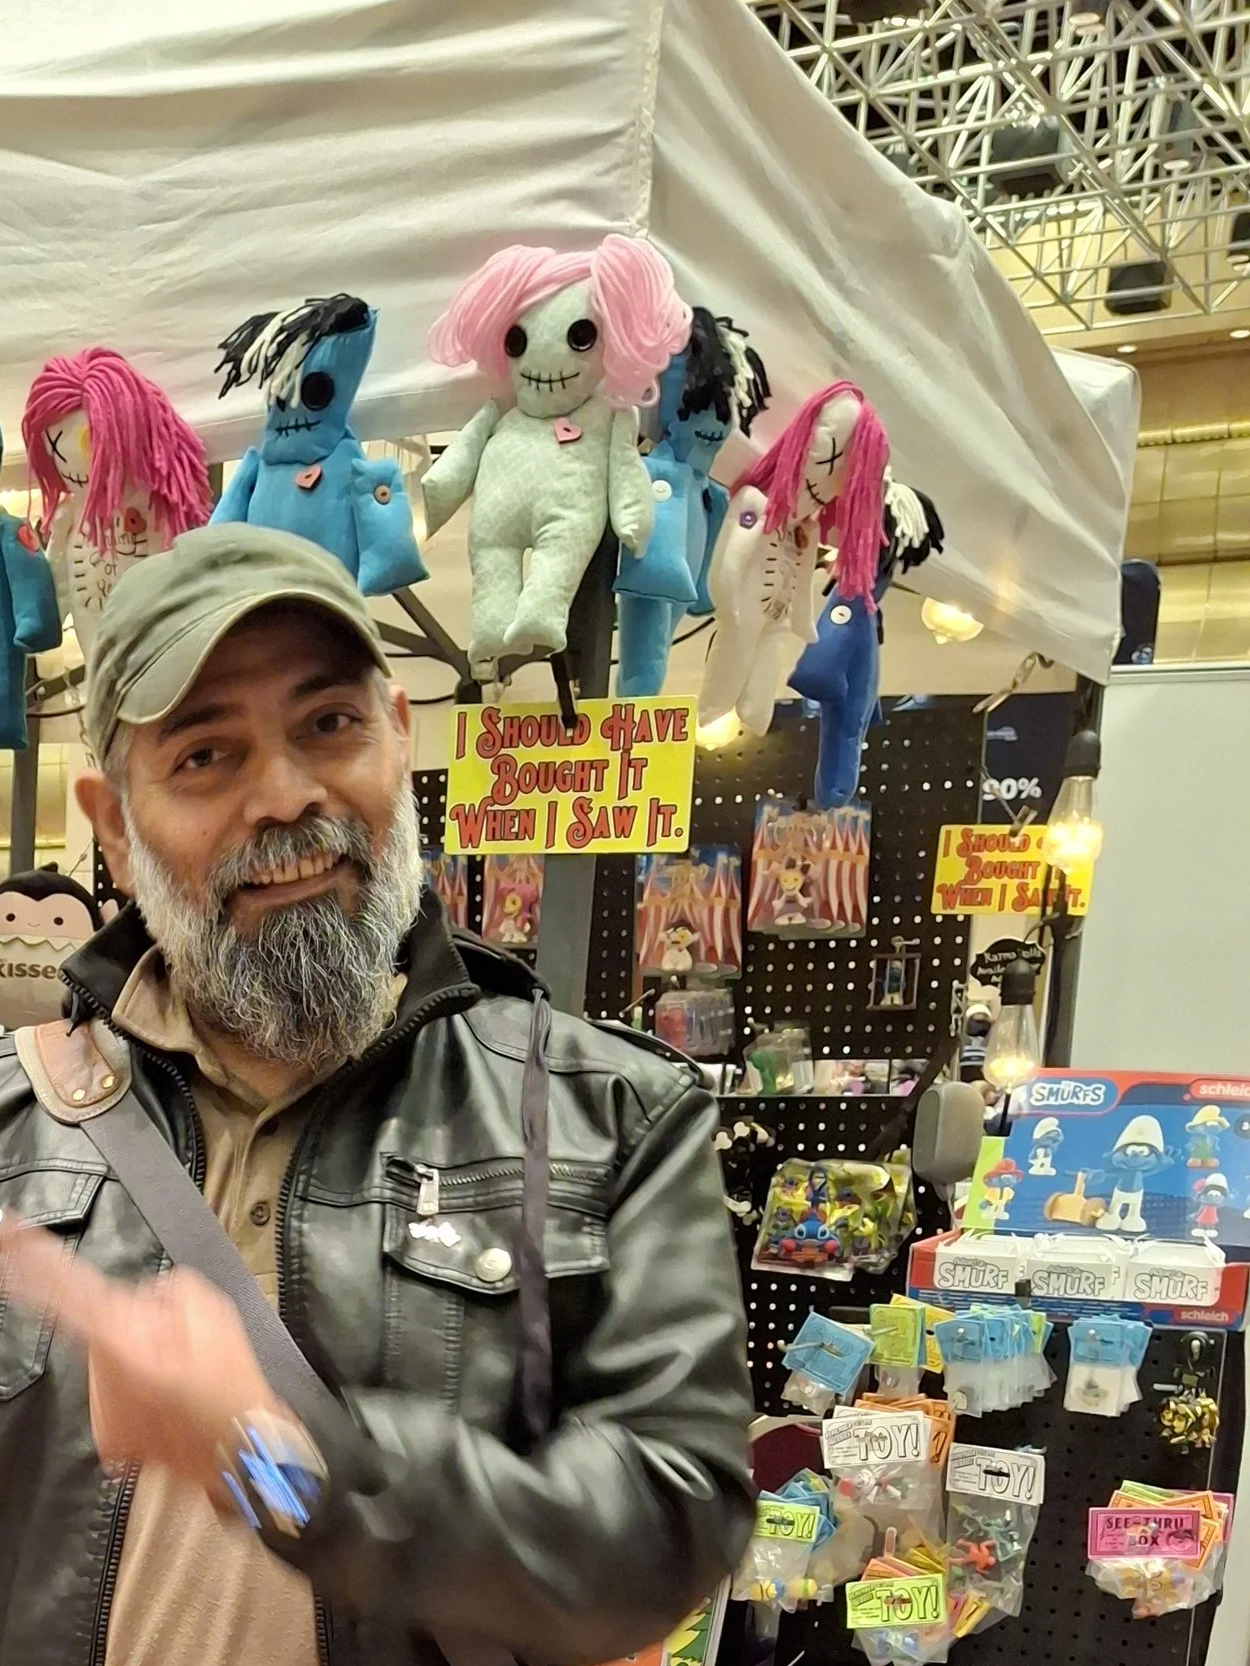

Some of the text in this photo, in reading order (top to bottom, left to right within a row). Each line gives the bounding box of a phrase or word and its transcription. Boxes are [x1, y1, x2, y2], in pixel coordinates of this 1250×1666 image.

[456, 704, 689, 759] I SHOULD HAVE
[491, 751, 648, 806] BOUGHT IT
[450, 796, 684, 849] WHEN I SAW IT.
[943, 830, 951, 858] I
[956, 828, 1030, 858] SHOULD
[964, 855, 1040, 885] BOUGHT
[936, 881, 993, 910] WHEN
[998, 884, 1006, 912] I
[1032, 1082, 1250, 1104] SMURFS schleic
[939, 1262, 1008, 1290] SMURF
[1032, 1270, 1105, 1297] SMURF
[1134, 1272, 1208, 1301] SMURF
[1181, 1311, 1229, 1323] schleich
[853, 1424, 920, 1461] TOY!
[975, 1457, 1036, 1500] TOY!
[767, 1511, 816, 1539] TOY!
[875, 1585, 939, 1622] TOY!
